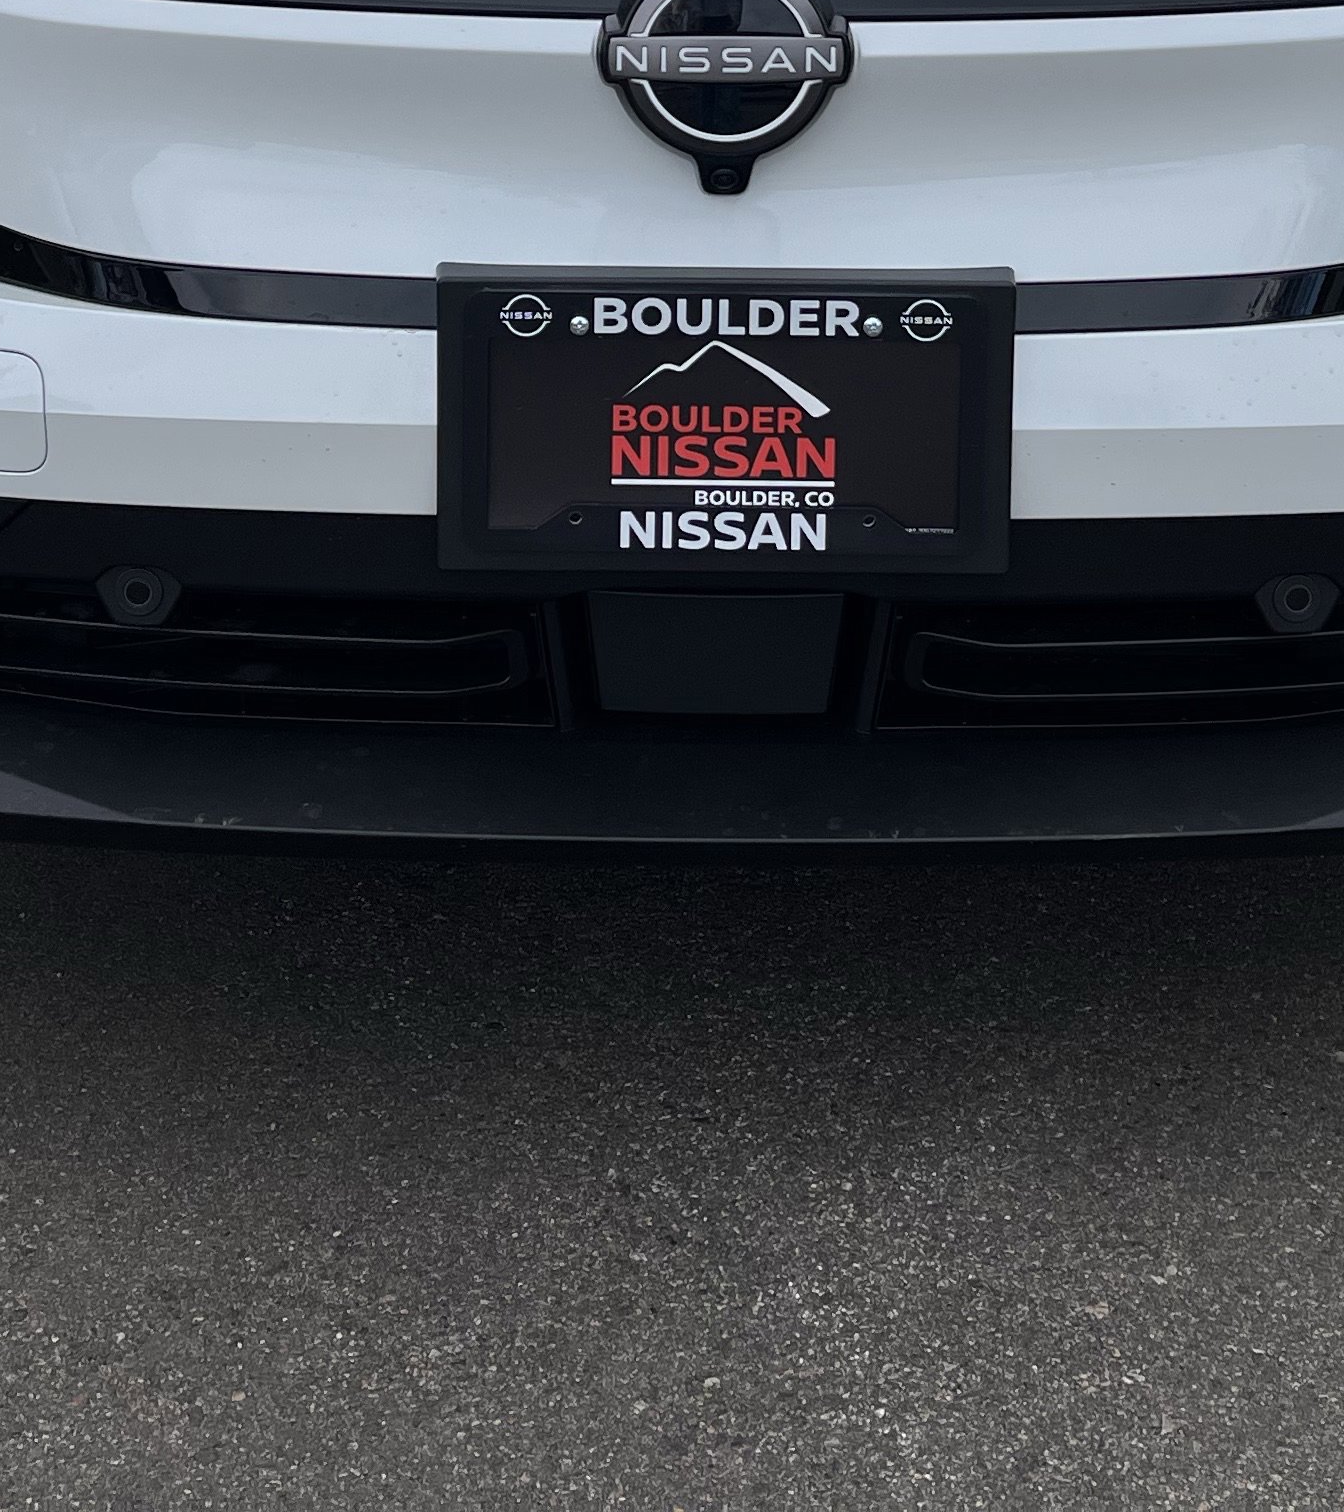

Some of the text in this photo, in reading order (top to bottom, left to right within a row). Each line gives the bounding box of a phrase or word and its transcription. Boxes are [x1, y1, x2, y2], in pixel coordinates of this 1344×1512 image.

[615, 45, 838, 74] NISSAN
[499, 310, 553, 321] NISSAN
[592, 296, 860, 338] BOULDER
[899, 314, 953, 326] NISSAN
[611, 404, 803, 434] BOULDER
[610, 435, 836, 479] NISSAN
[694, 489, 834, 508] BOULDER, CO
[619, 510, 827, 551] NISSAN
